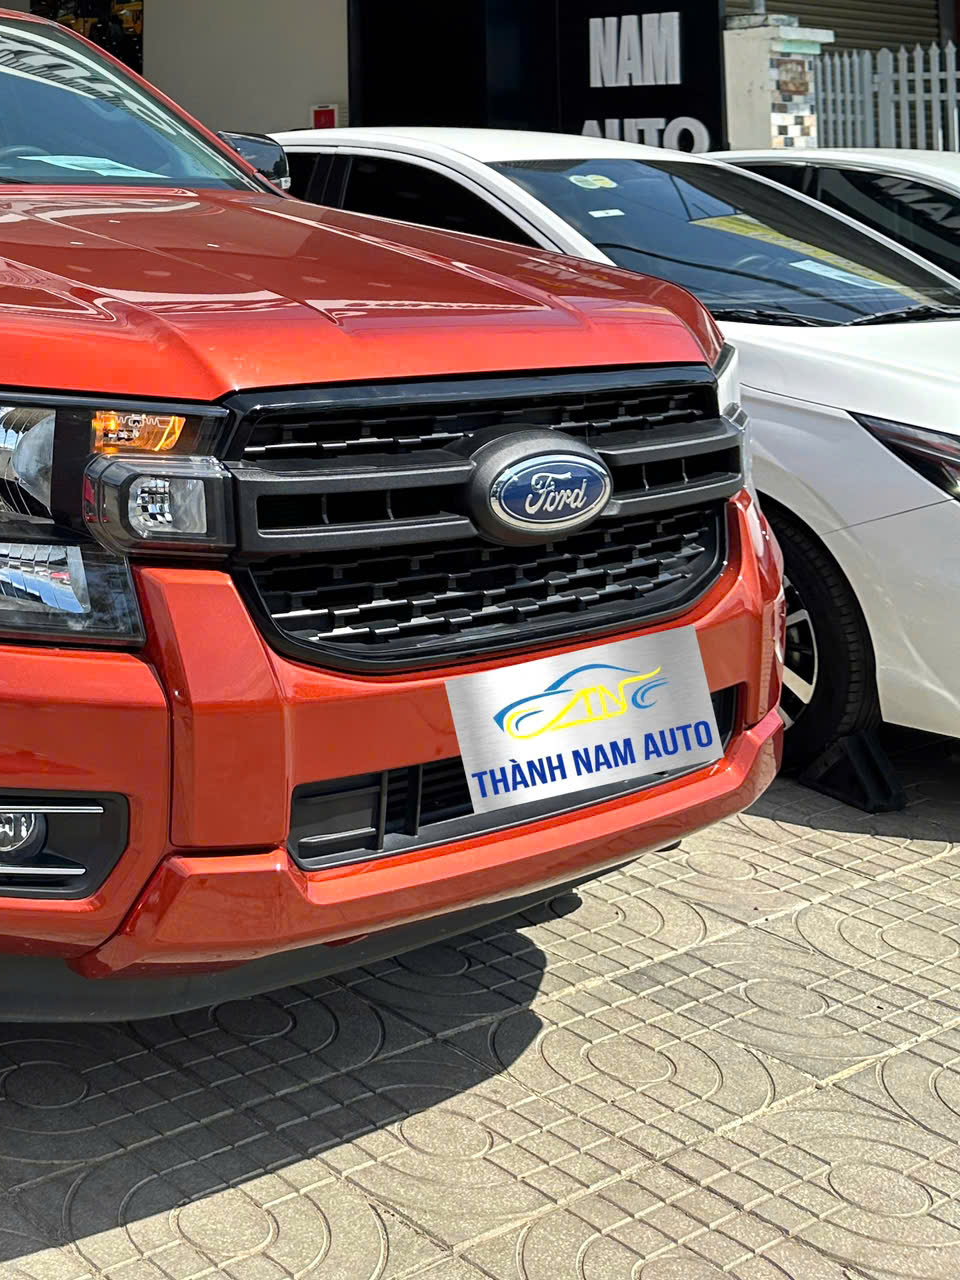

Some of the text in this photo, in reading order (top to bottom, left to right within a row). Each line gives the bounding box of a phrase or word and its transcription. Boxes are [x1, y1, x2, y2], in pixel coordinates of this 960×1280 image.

[589, 11, 682, 88] NAM
[525, 471, 587, 515] Ford
[472, 720, 713, 798] THÀNH NAM AUTO
